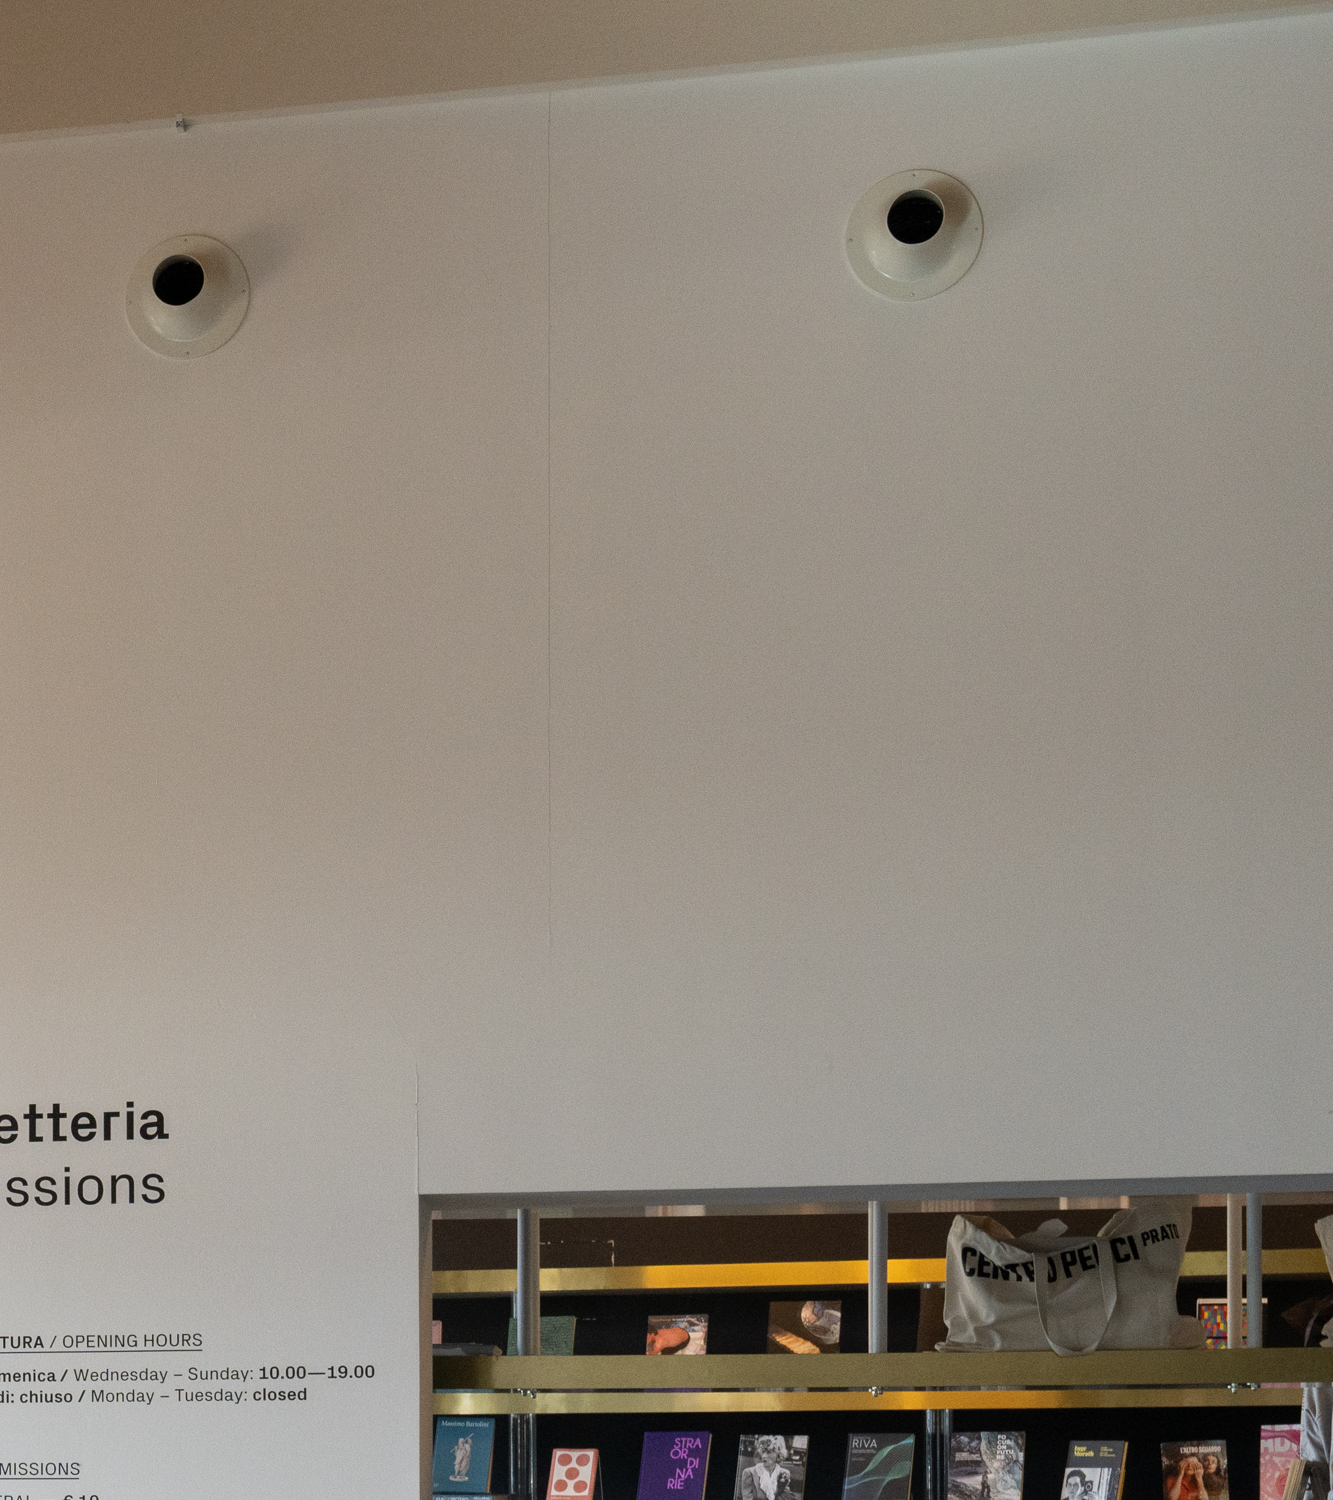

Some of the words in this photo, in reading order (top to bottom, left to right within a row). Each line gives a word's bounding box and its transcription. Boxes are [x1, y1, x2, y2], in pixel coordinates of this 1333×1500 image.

[1141, 1223, 1180, 1247] PRATO
[50, 1335, 57, 1349] /
[63, 1334, 137, 1349] OPENING
[144, 1333, 202, 1348] HOURS
[60, 1369, 68, 1382] /
[74, 1367, 167, 1384] Wednesday
[188, 1366, 253, 1383] Sunday:
[259, 1364, 375, 1380] 10.00—19.00
[20, 1389, 72, 1404] chiuso
[78, 1389, 85, 1403] /
[92, 1388, 154, 1406] Monday
[175, 1388, 247, 1405] Tuesday:
[253, 1387, 306, 1402] closed
[441, 1420, 465, 1428] Massimo
[466, 1420, 489, 1428] Bartolini
[674, 1437, 702, 1449] STRA
[852, 1439, 877, 1449] RIVA
[670, 1448, 688, 1459] OR
[687, 1457, 699, 1469] DI
[675, 1468, 694, 1479] NA
[667, 1478, 685, 1490] RIE
